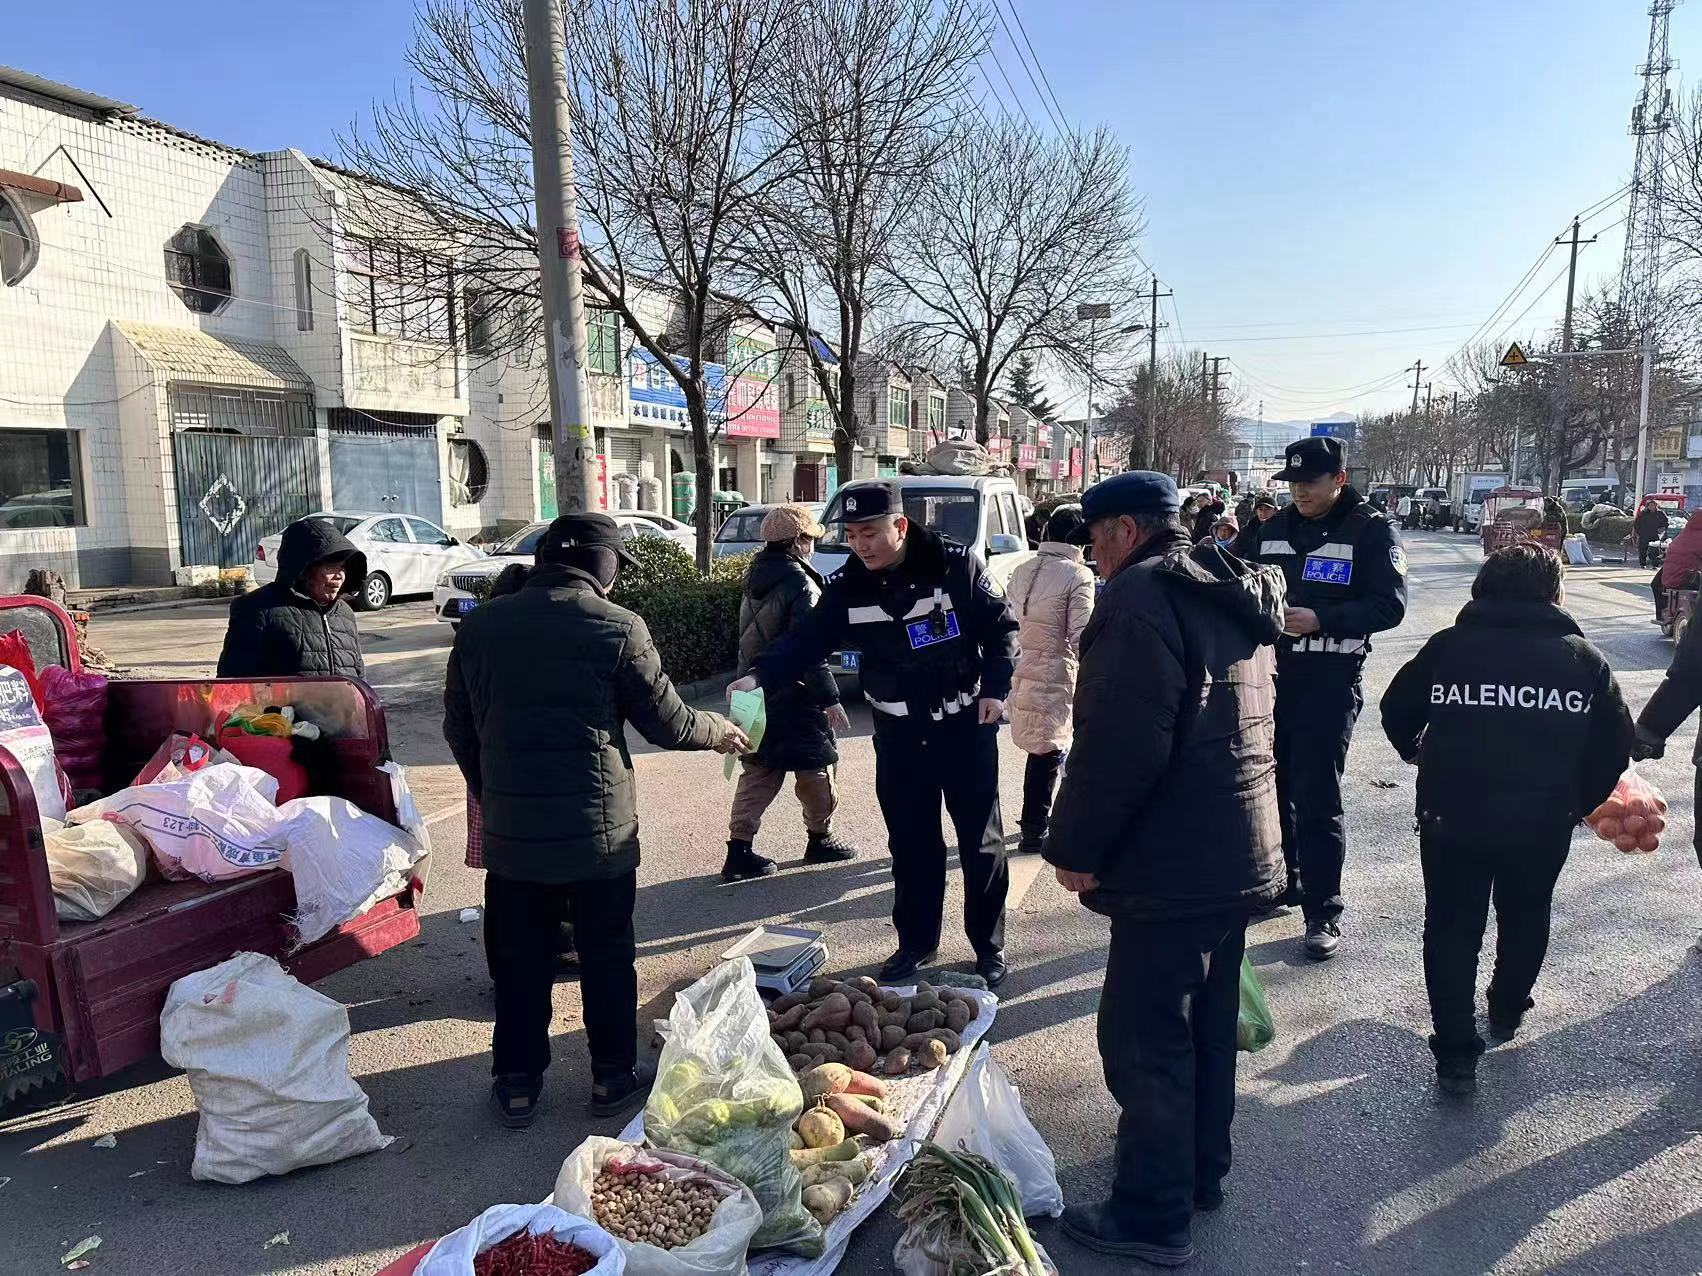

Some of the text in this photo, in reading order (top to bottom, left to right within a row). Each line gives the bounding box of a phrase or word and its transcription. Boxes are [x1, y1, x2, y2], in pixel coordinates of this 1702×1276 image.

[1312, 560, 1345, 573] 警察
[1306, 570, 1346, 582] POLICE
[914, 627, 955, 646] POLE
